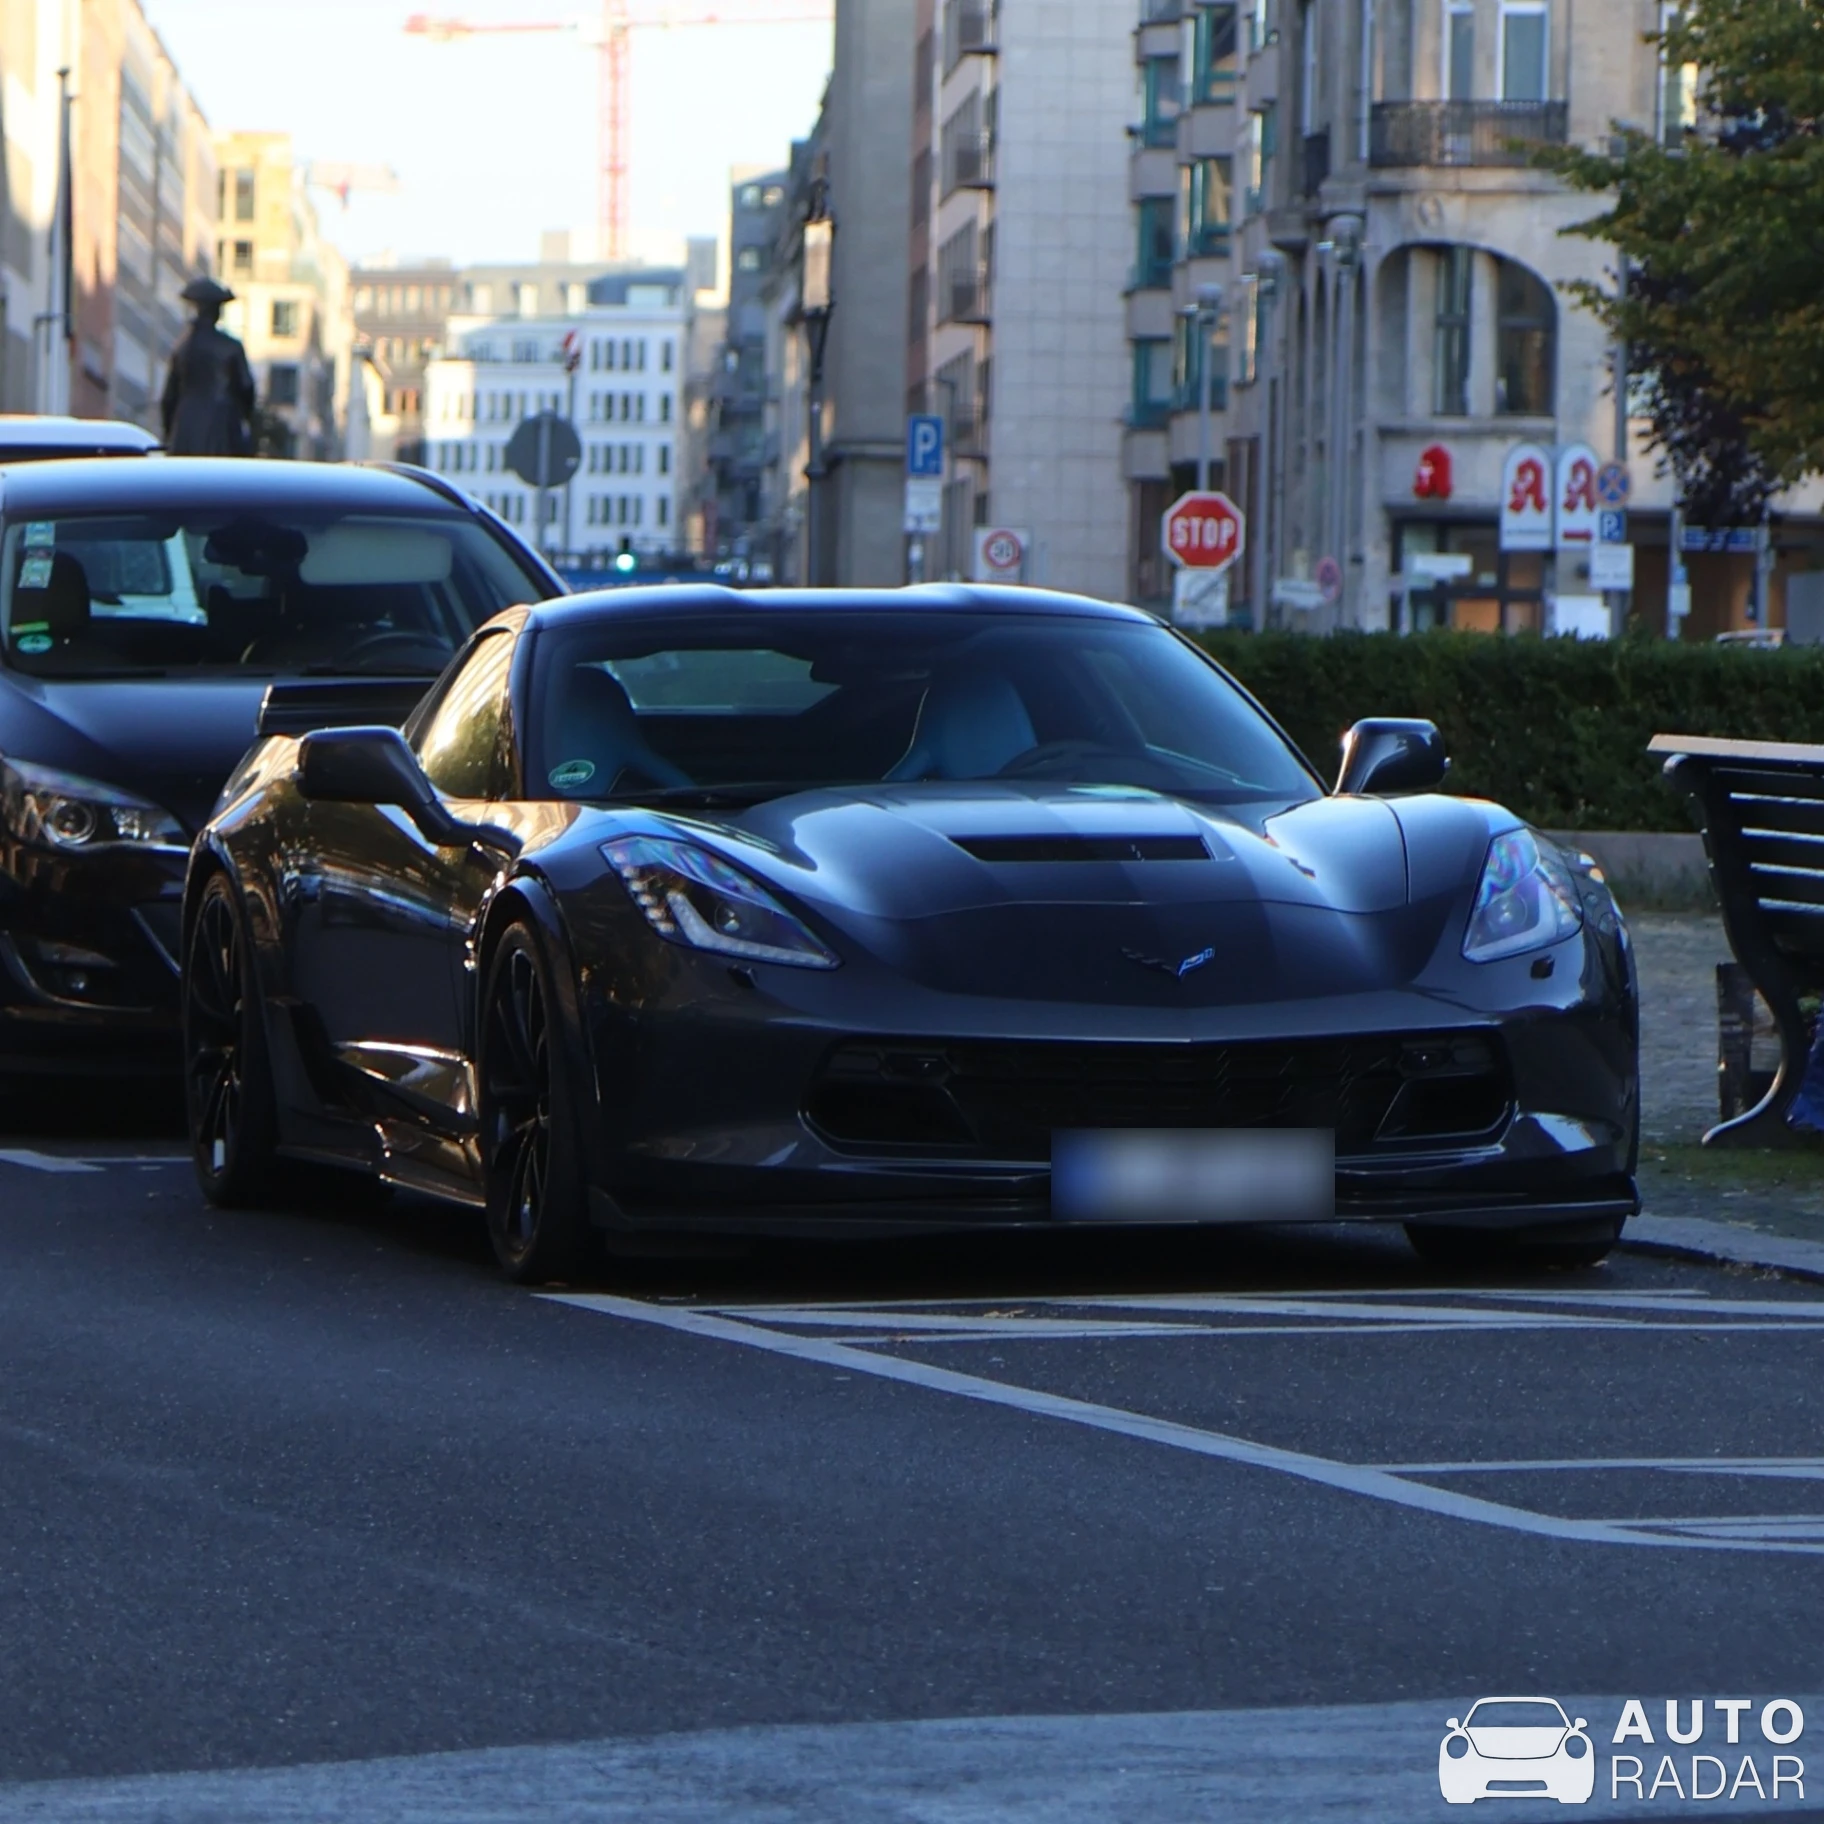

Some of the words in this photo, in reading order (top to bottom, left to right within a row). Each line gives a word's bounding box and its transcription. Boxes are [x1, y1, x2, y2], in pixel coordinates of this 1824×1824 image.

[914, 422, 938, 469] P
[1171, 515, 1236, 550] STOP
[1602, 513, 1618, 539] P
